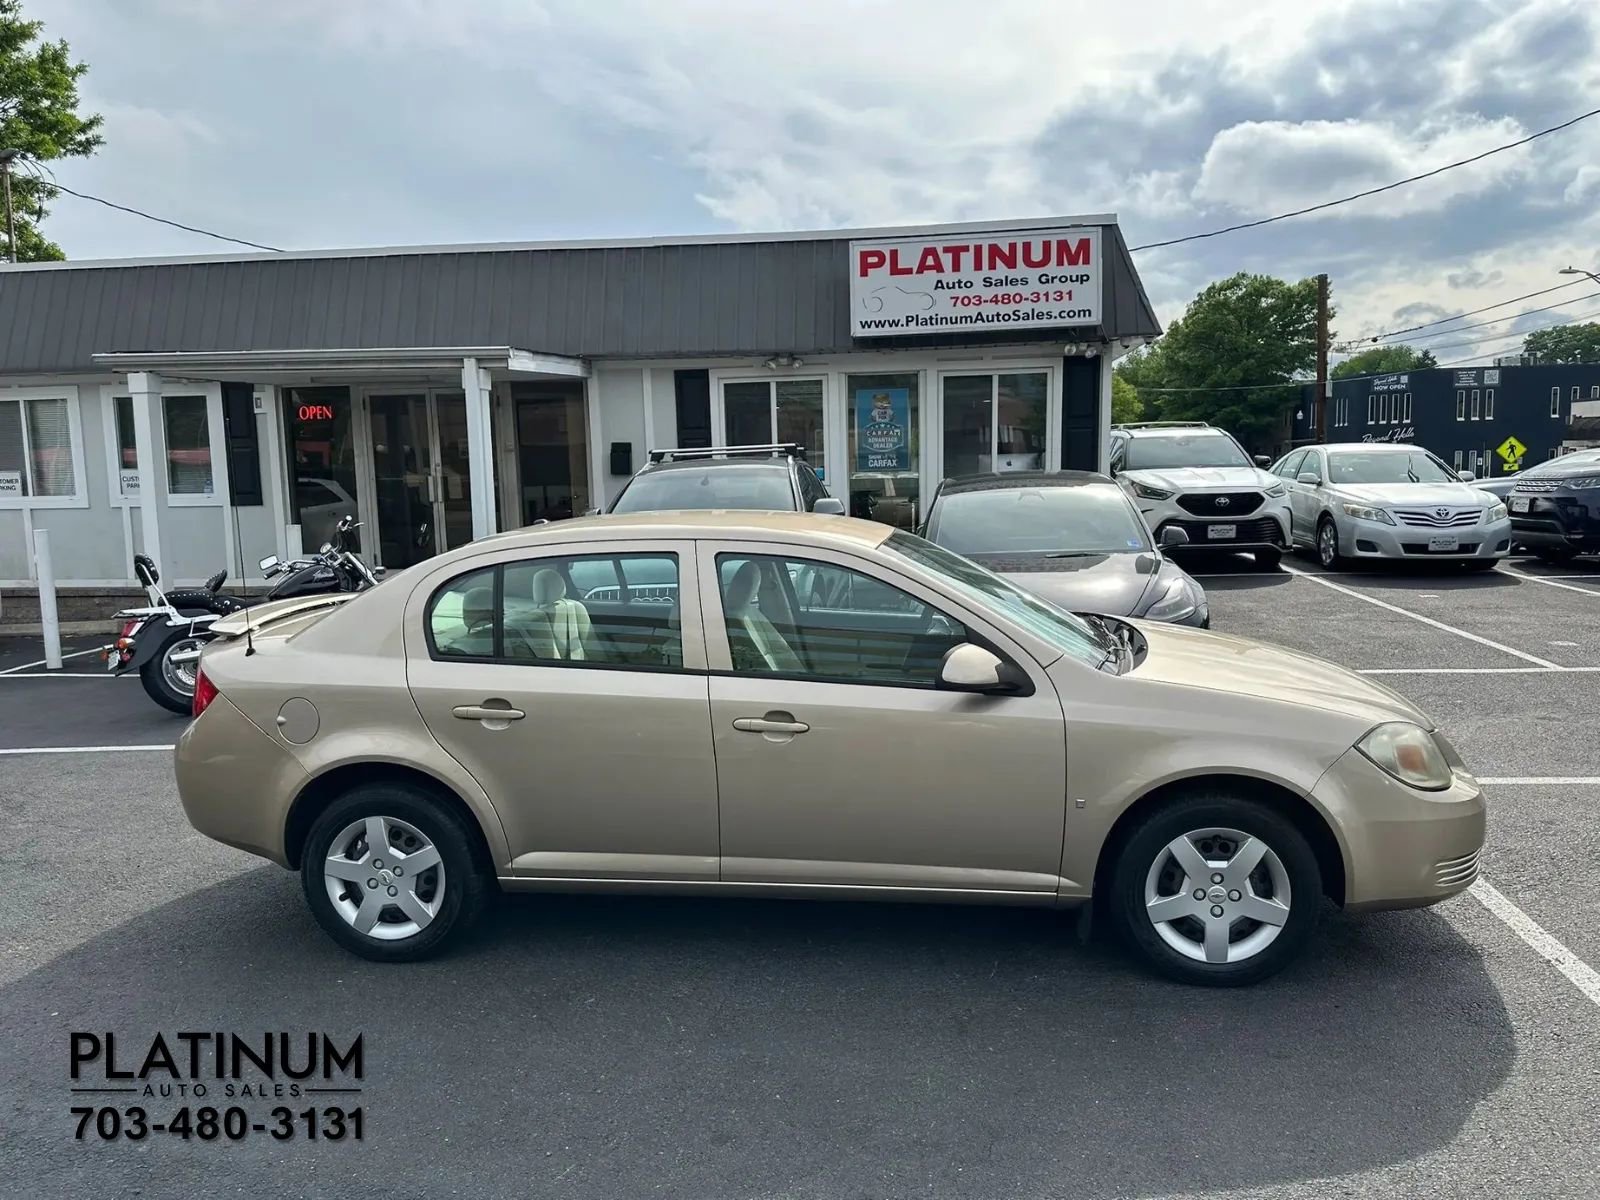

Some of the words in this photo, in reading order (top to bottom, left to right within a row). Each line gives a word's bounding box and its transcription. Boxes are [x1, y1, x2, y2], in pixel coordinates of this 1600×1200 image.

[859, 238, 1091, 277] PLATINUM
[934, 279, 973, 291] Auto
[982, 275, 1029, 288] Sales
[1038, 273, 1090, 286] Group
[950, 290, 1073, 307] 703-480-3131
[859, 308, 1092, 329] www.PlatinumAutoSales.com
[299, 405, 332, 420] OPEN
[868, 459, 897, 468] CARFAX
